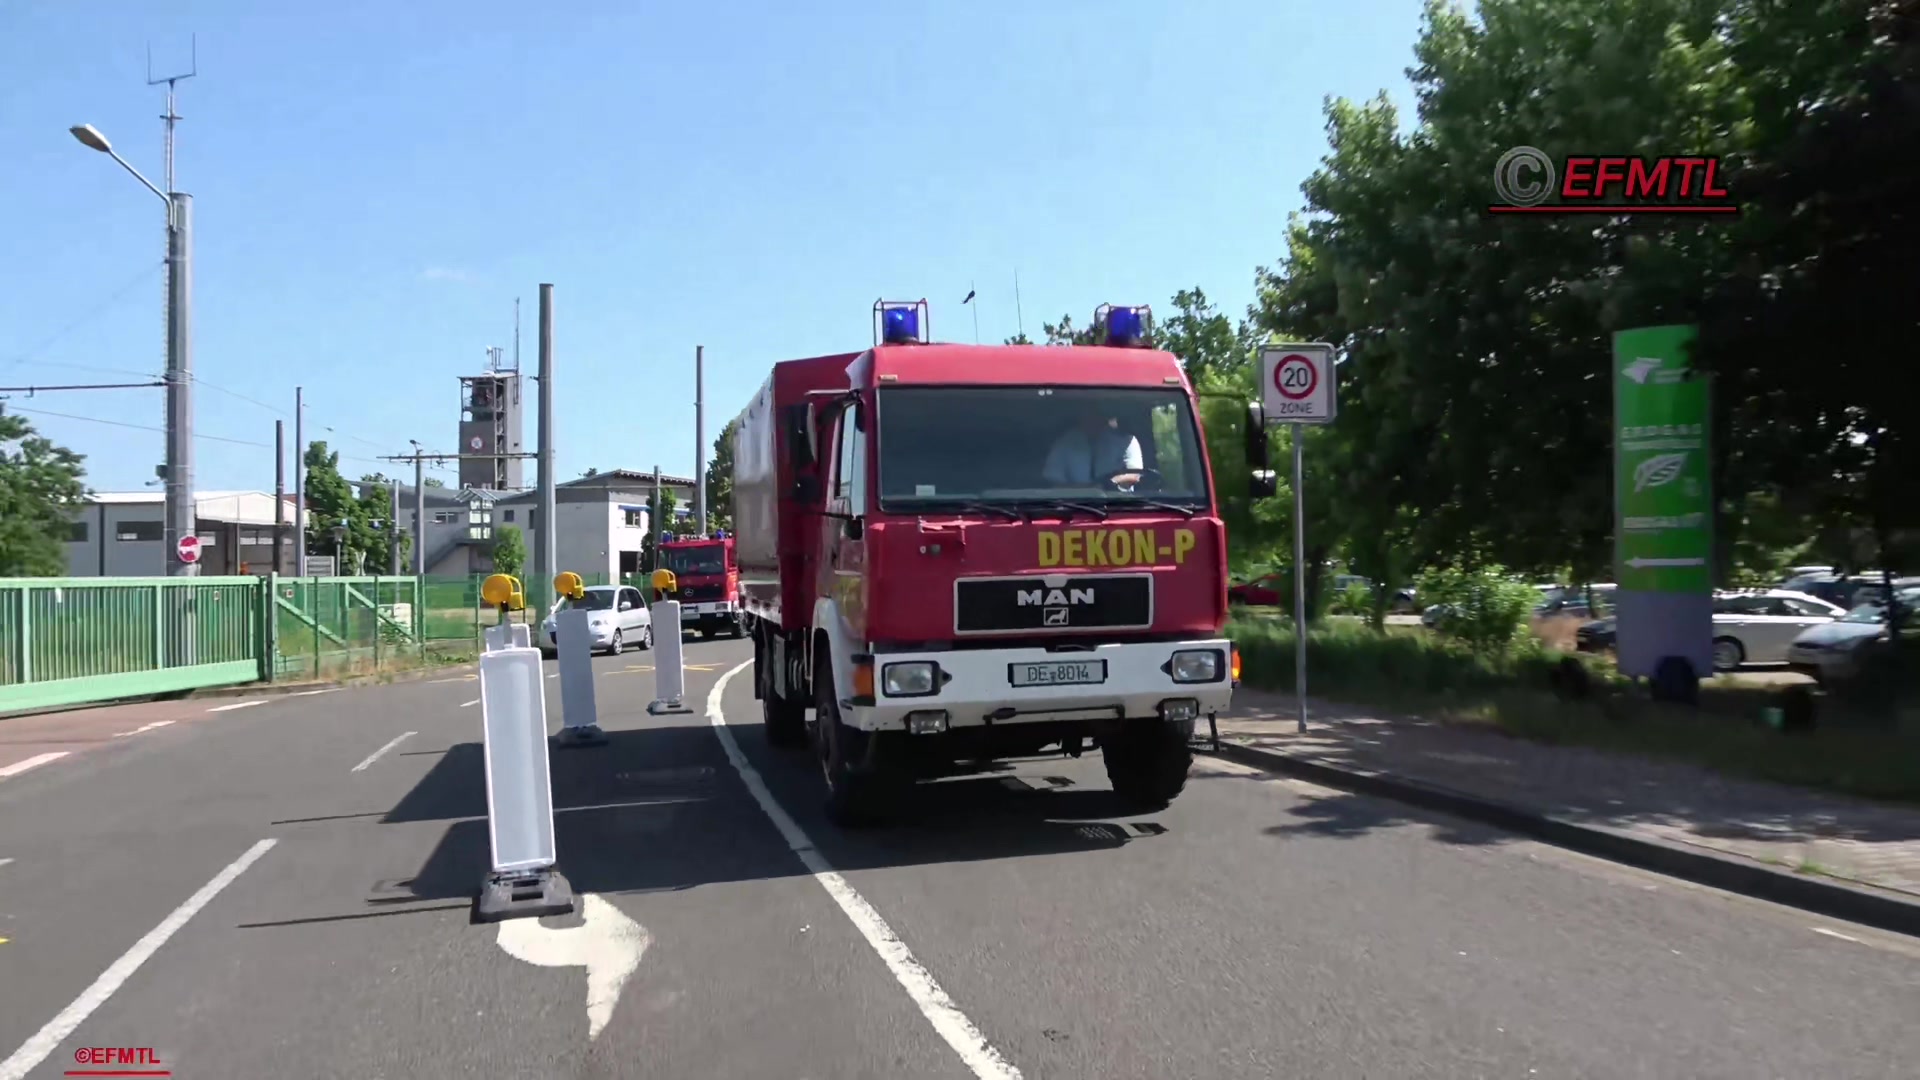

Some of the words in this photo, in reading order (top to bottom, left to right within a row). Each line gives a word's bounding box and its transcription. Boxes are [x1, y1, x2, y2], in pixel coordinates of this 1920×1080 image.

[1284, 367, 1308, 387] 20
[1280, 402, 1313, 414] ZONE
[1038, 529, 1196, 566] DEKON-P
[1017, 587, 1095, 606] MAN
